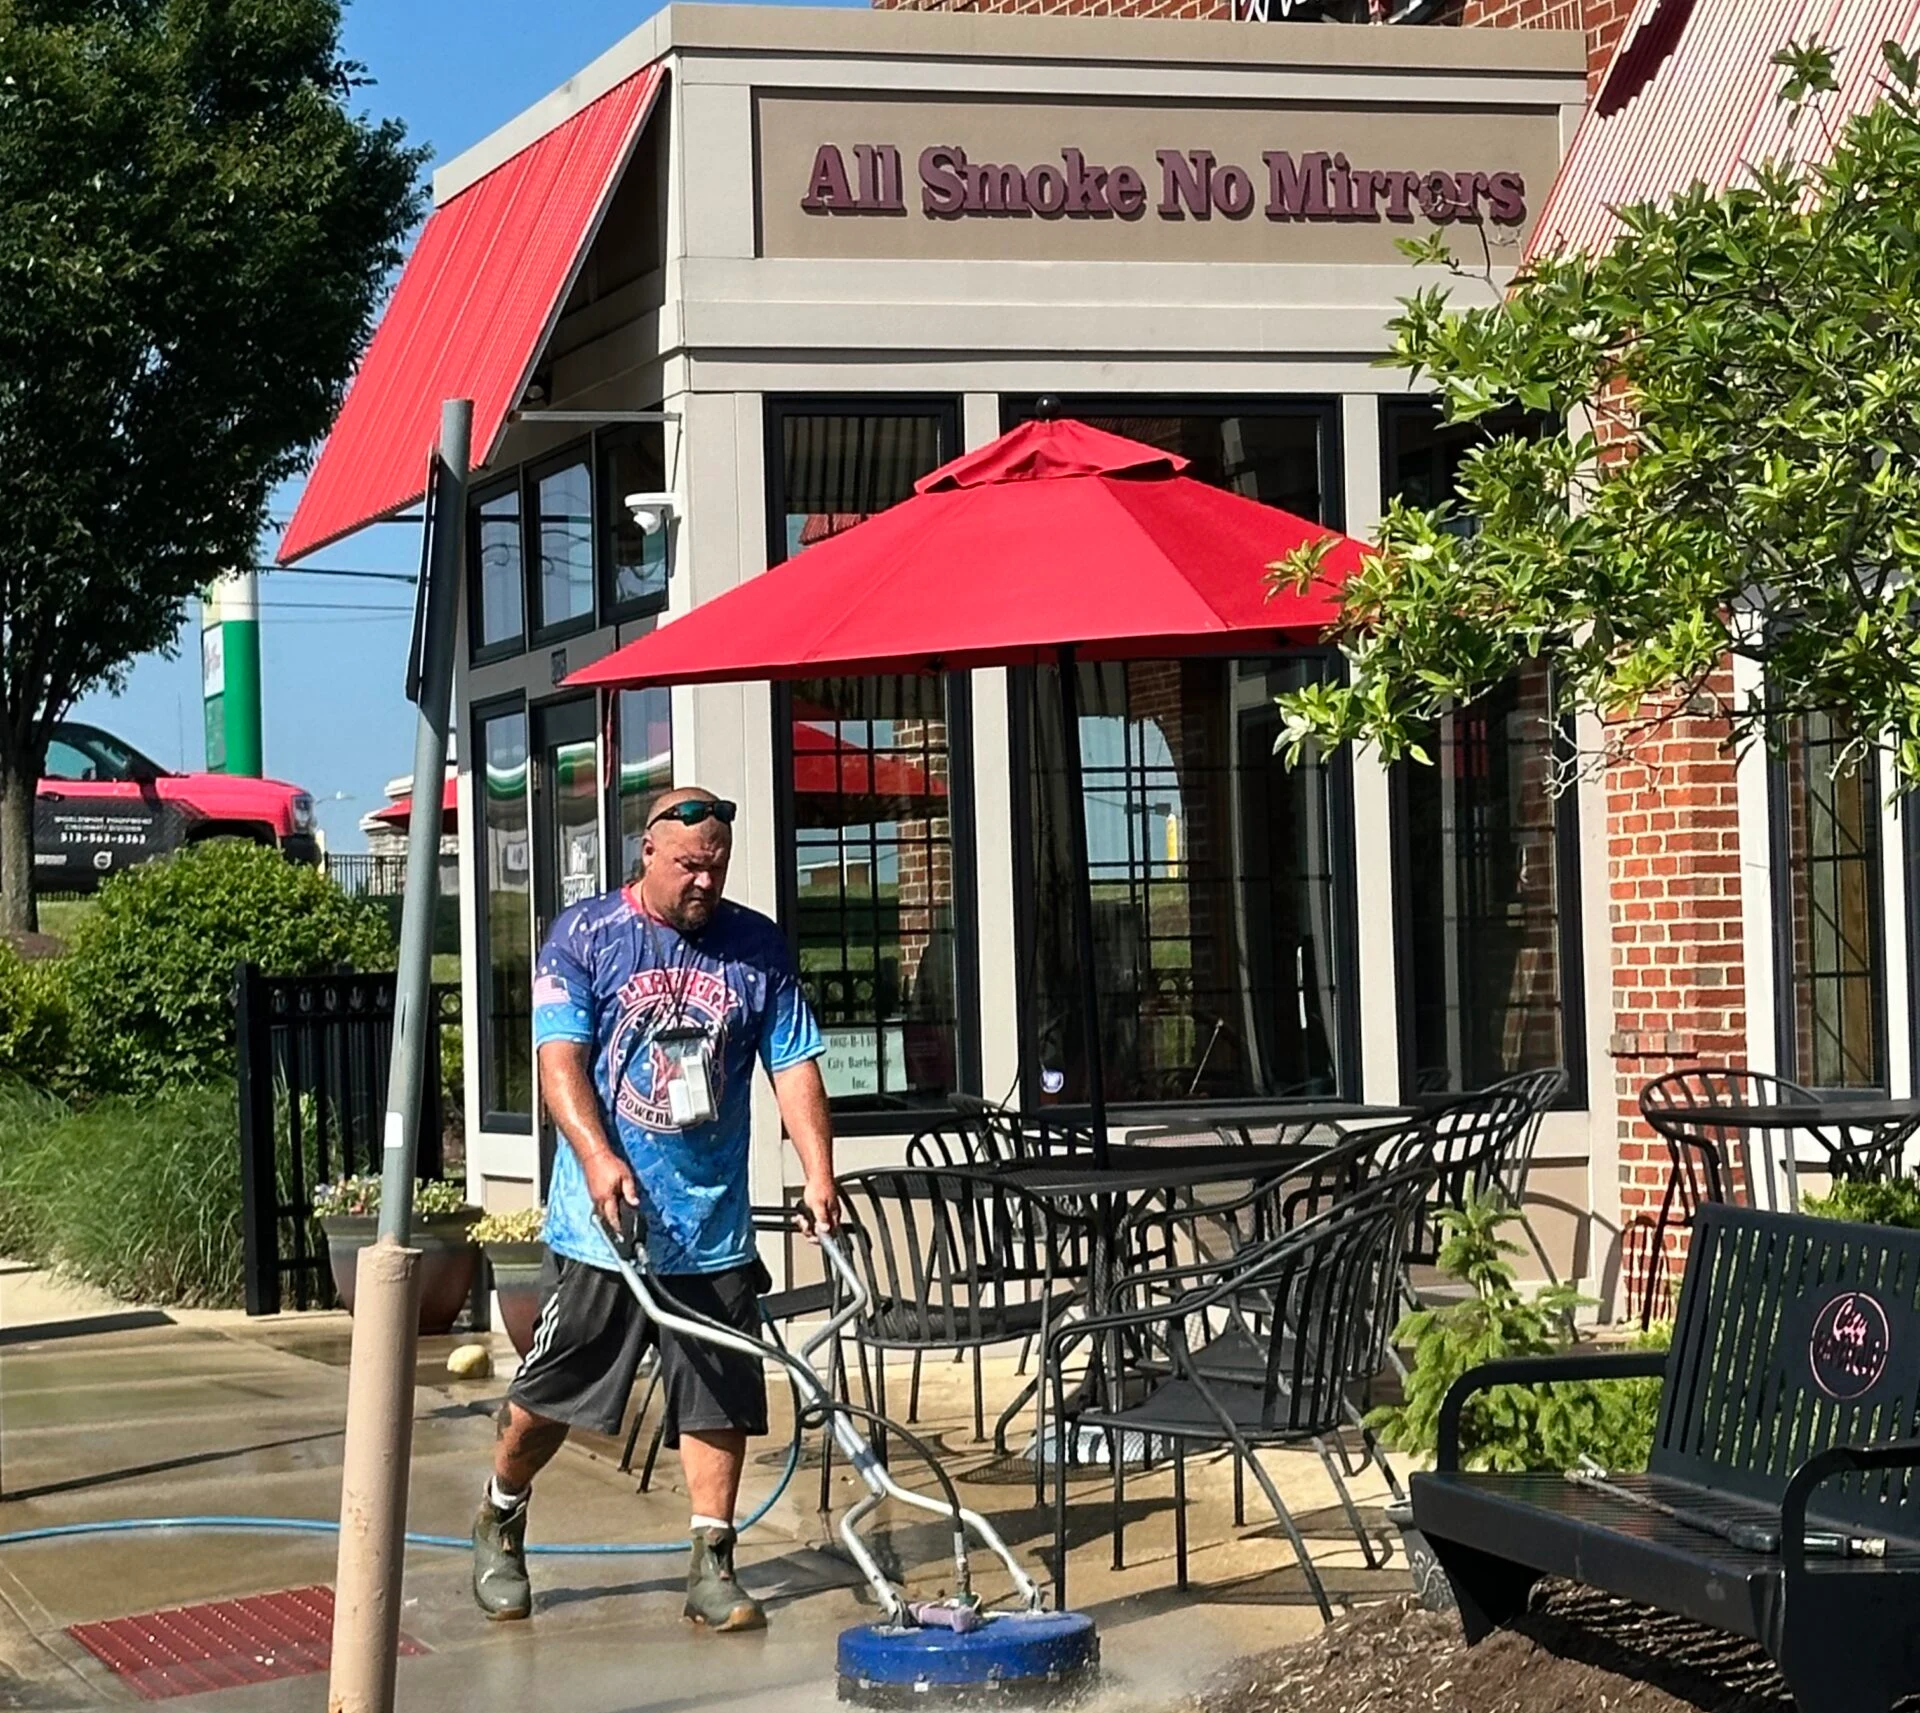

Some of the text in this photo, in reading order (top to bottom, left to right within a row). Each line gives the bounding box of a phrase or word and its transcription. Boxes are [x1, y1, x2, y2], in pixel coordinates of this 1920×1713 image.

[801, 144, 1527, 226] All Smoke No Mirrors
